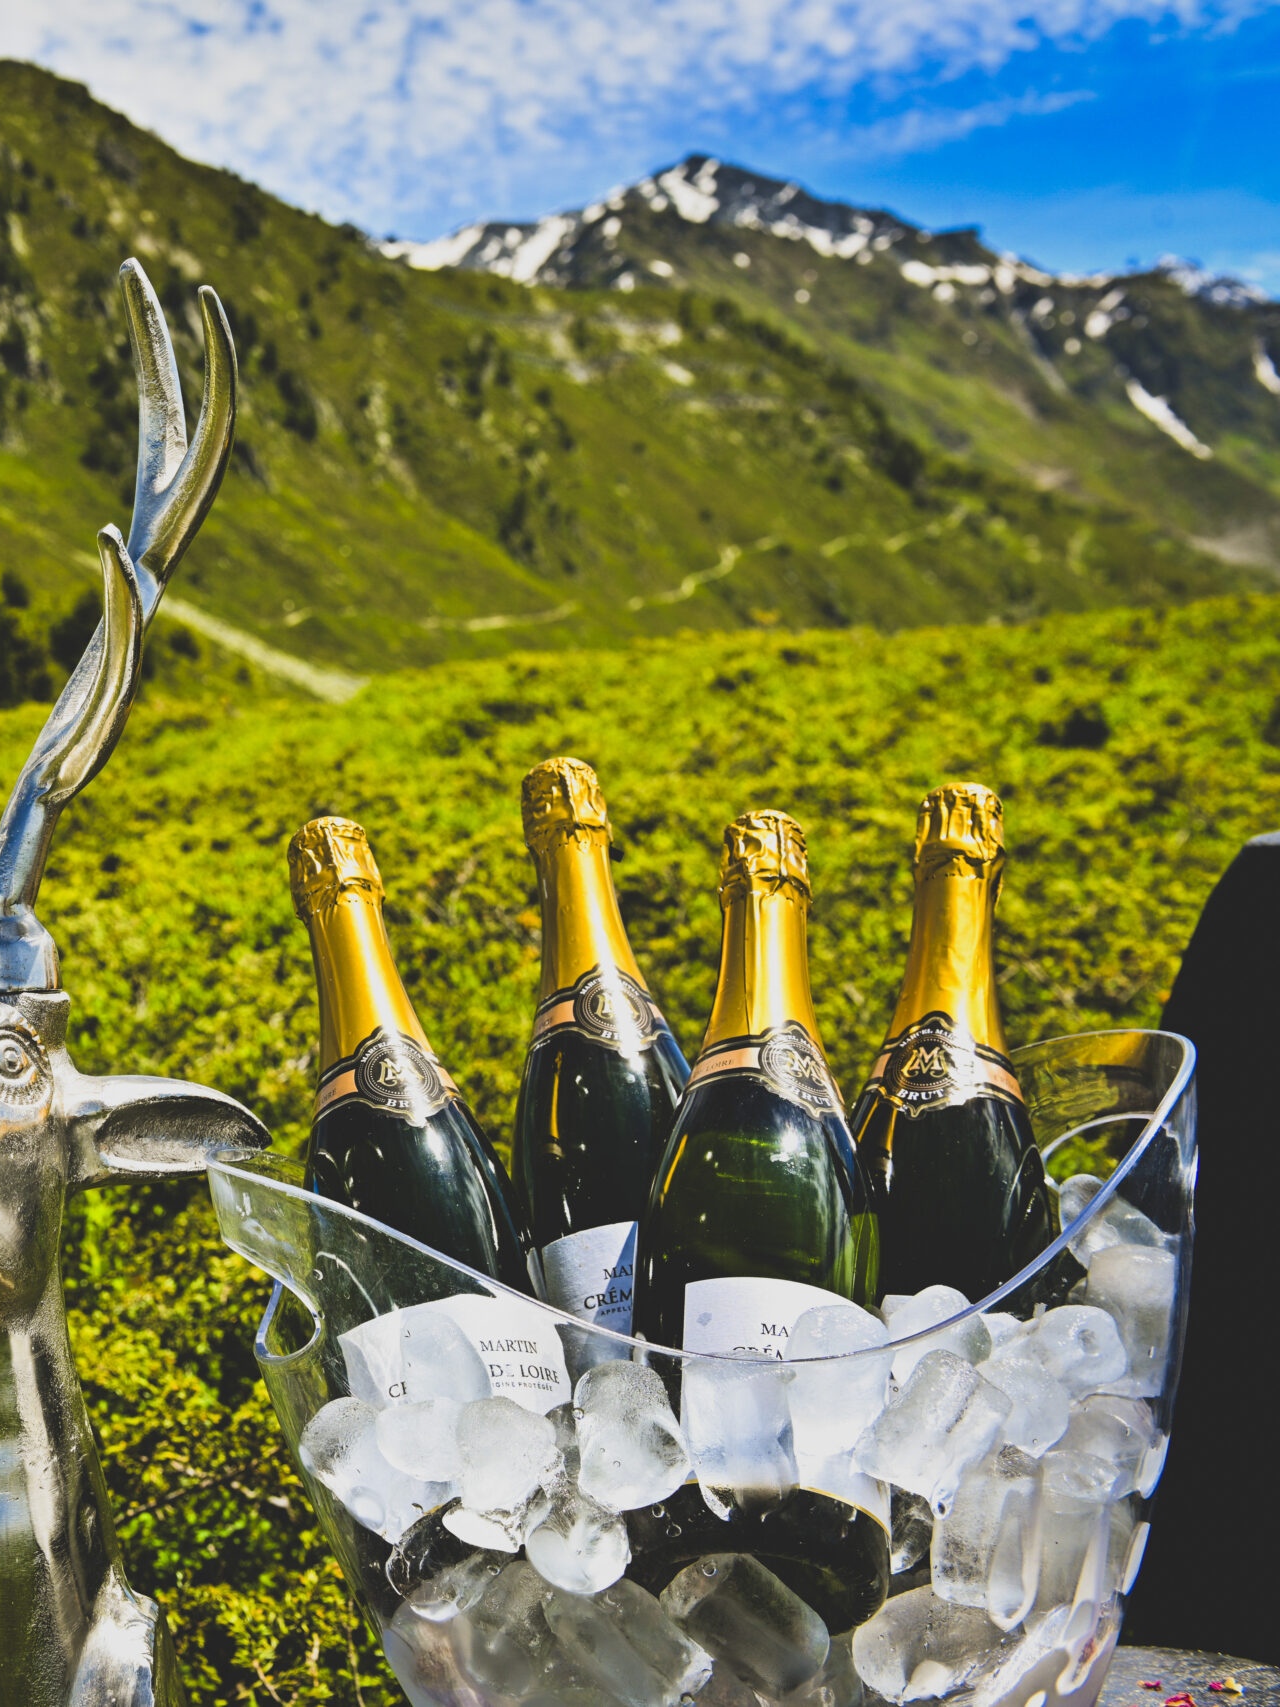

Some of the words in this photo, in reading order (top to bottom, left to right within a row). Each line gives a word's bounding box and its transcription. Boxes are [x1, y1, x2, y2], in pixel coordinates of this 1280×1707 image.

[896, 1088, 945, 1101] BRUT
[480, 1339, 538, 1354] MARTIN
[520, 1364, 560, 1384] LOIRE
